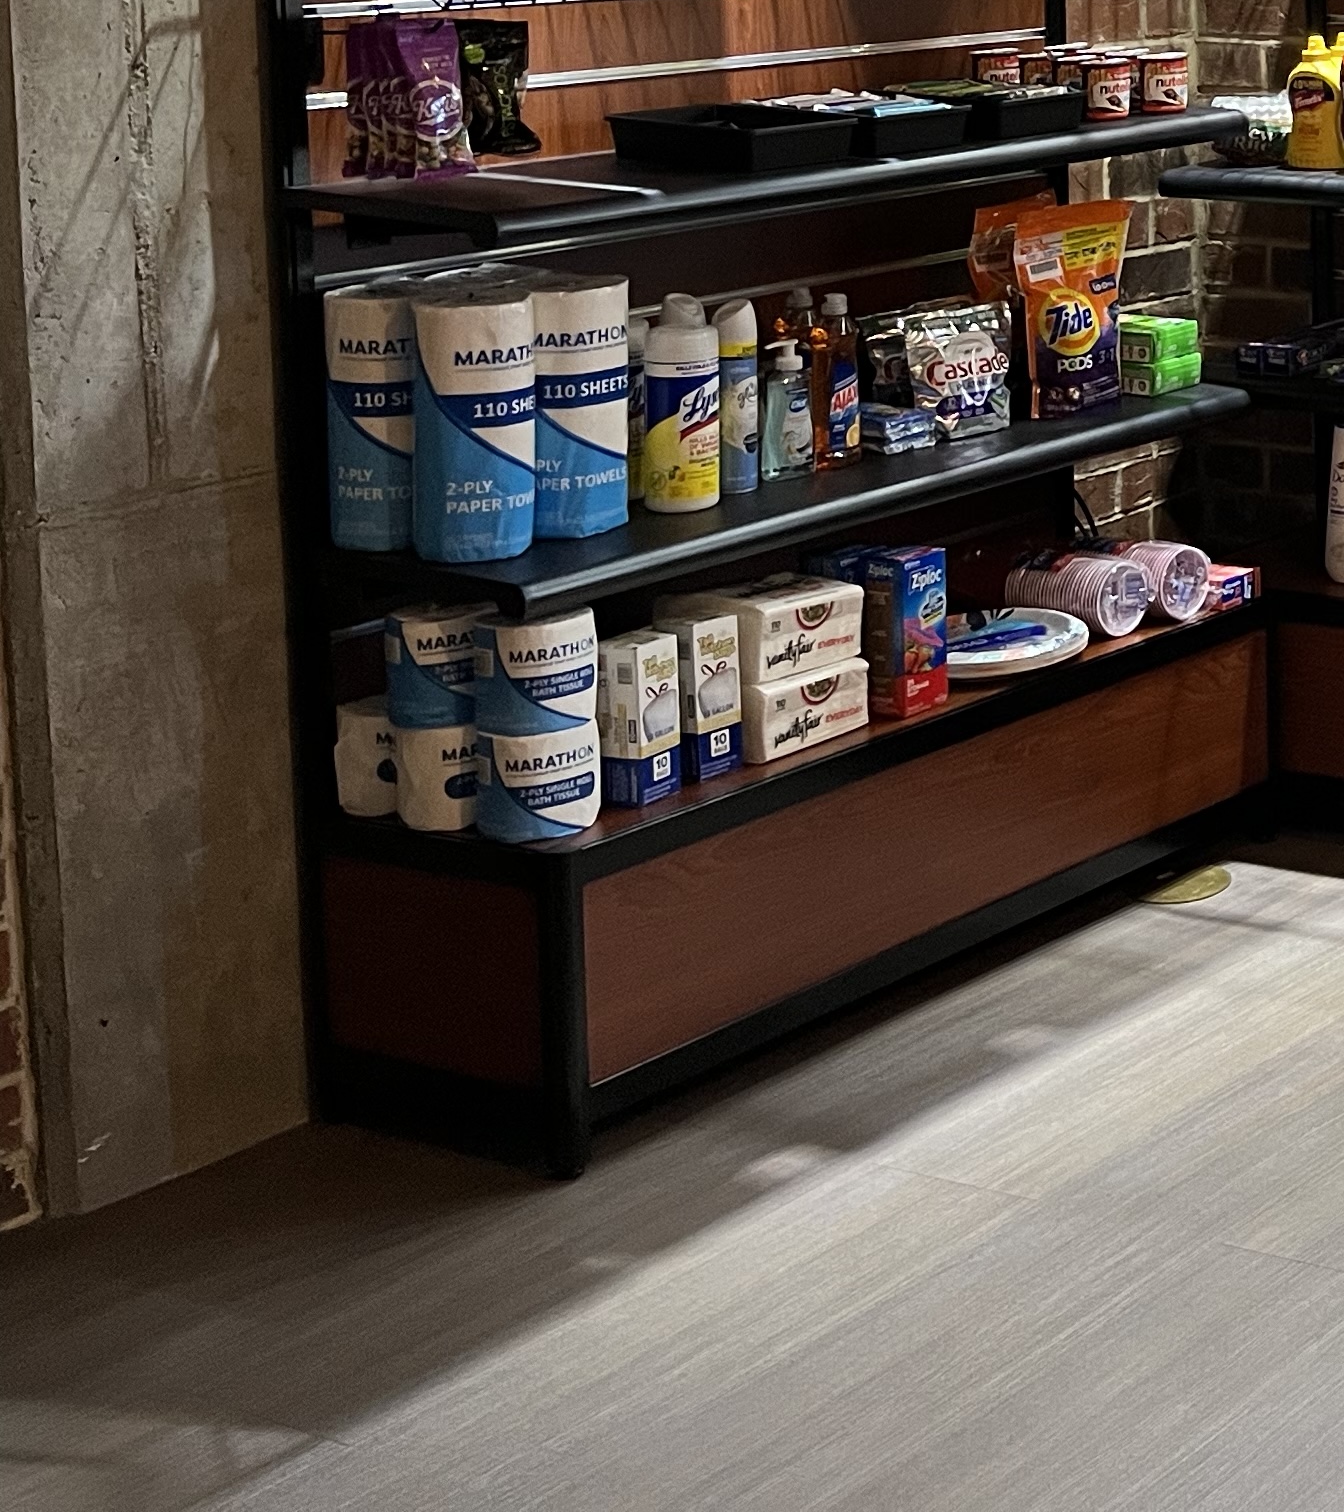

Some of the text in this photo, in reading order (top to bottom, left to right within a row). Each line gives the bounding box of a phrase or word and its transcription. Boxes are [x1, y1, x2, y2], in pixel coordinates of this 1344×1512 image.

[1100, 82, 1130, 95] nutel
[1046, 303, 1093, 345] Tide
[339, 339, 409, 355] MARAT
[454, 346, 535, 366] MARATH
[926, 352, 1009, 386] Cascade
[1057, 354, 1093, 373] PODS
[544, 374, 628, 399] 110 SHEETS
[355, 392, 385, 407] 110
[474, 396, 535, 418] 110 SHE
[338, 466, 373, 482] 2-PLY
[574, 466, 626, 488] TOWELS
[338, 487, 383, 501] PAPER
[447, 480, 493, 495] 2-PLY
[447, 490, 535, 514] PAPER TOW
[868, 564, 893, 577] Ziploc
[912, 568, 942, 591] Ziploc
[417, 630, 473, 651] MARA
[509, 635, 594, 663] MARATHON
[525, 679, 548, 689] 2-PLY
[550, 672, 578, 686] SINGLE
[532, 680, 584, 697] BATH TISSUE
[714, 733, 727, 745] 10
[505, 744, 594, 773] MARATHON
[656, 756, 667, 769] 10
[520, 780, 575, 798] 2-PLY SINGLE
[528, 788, 580, 806] BATH TISSUE
